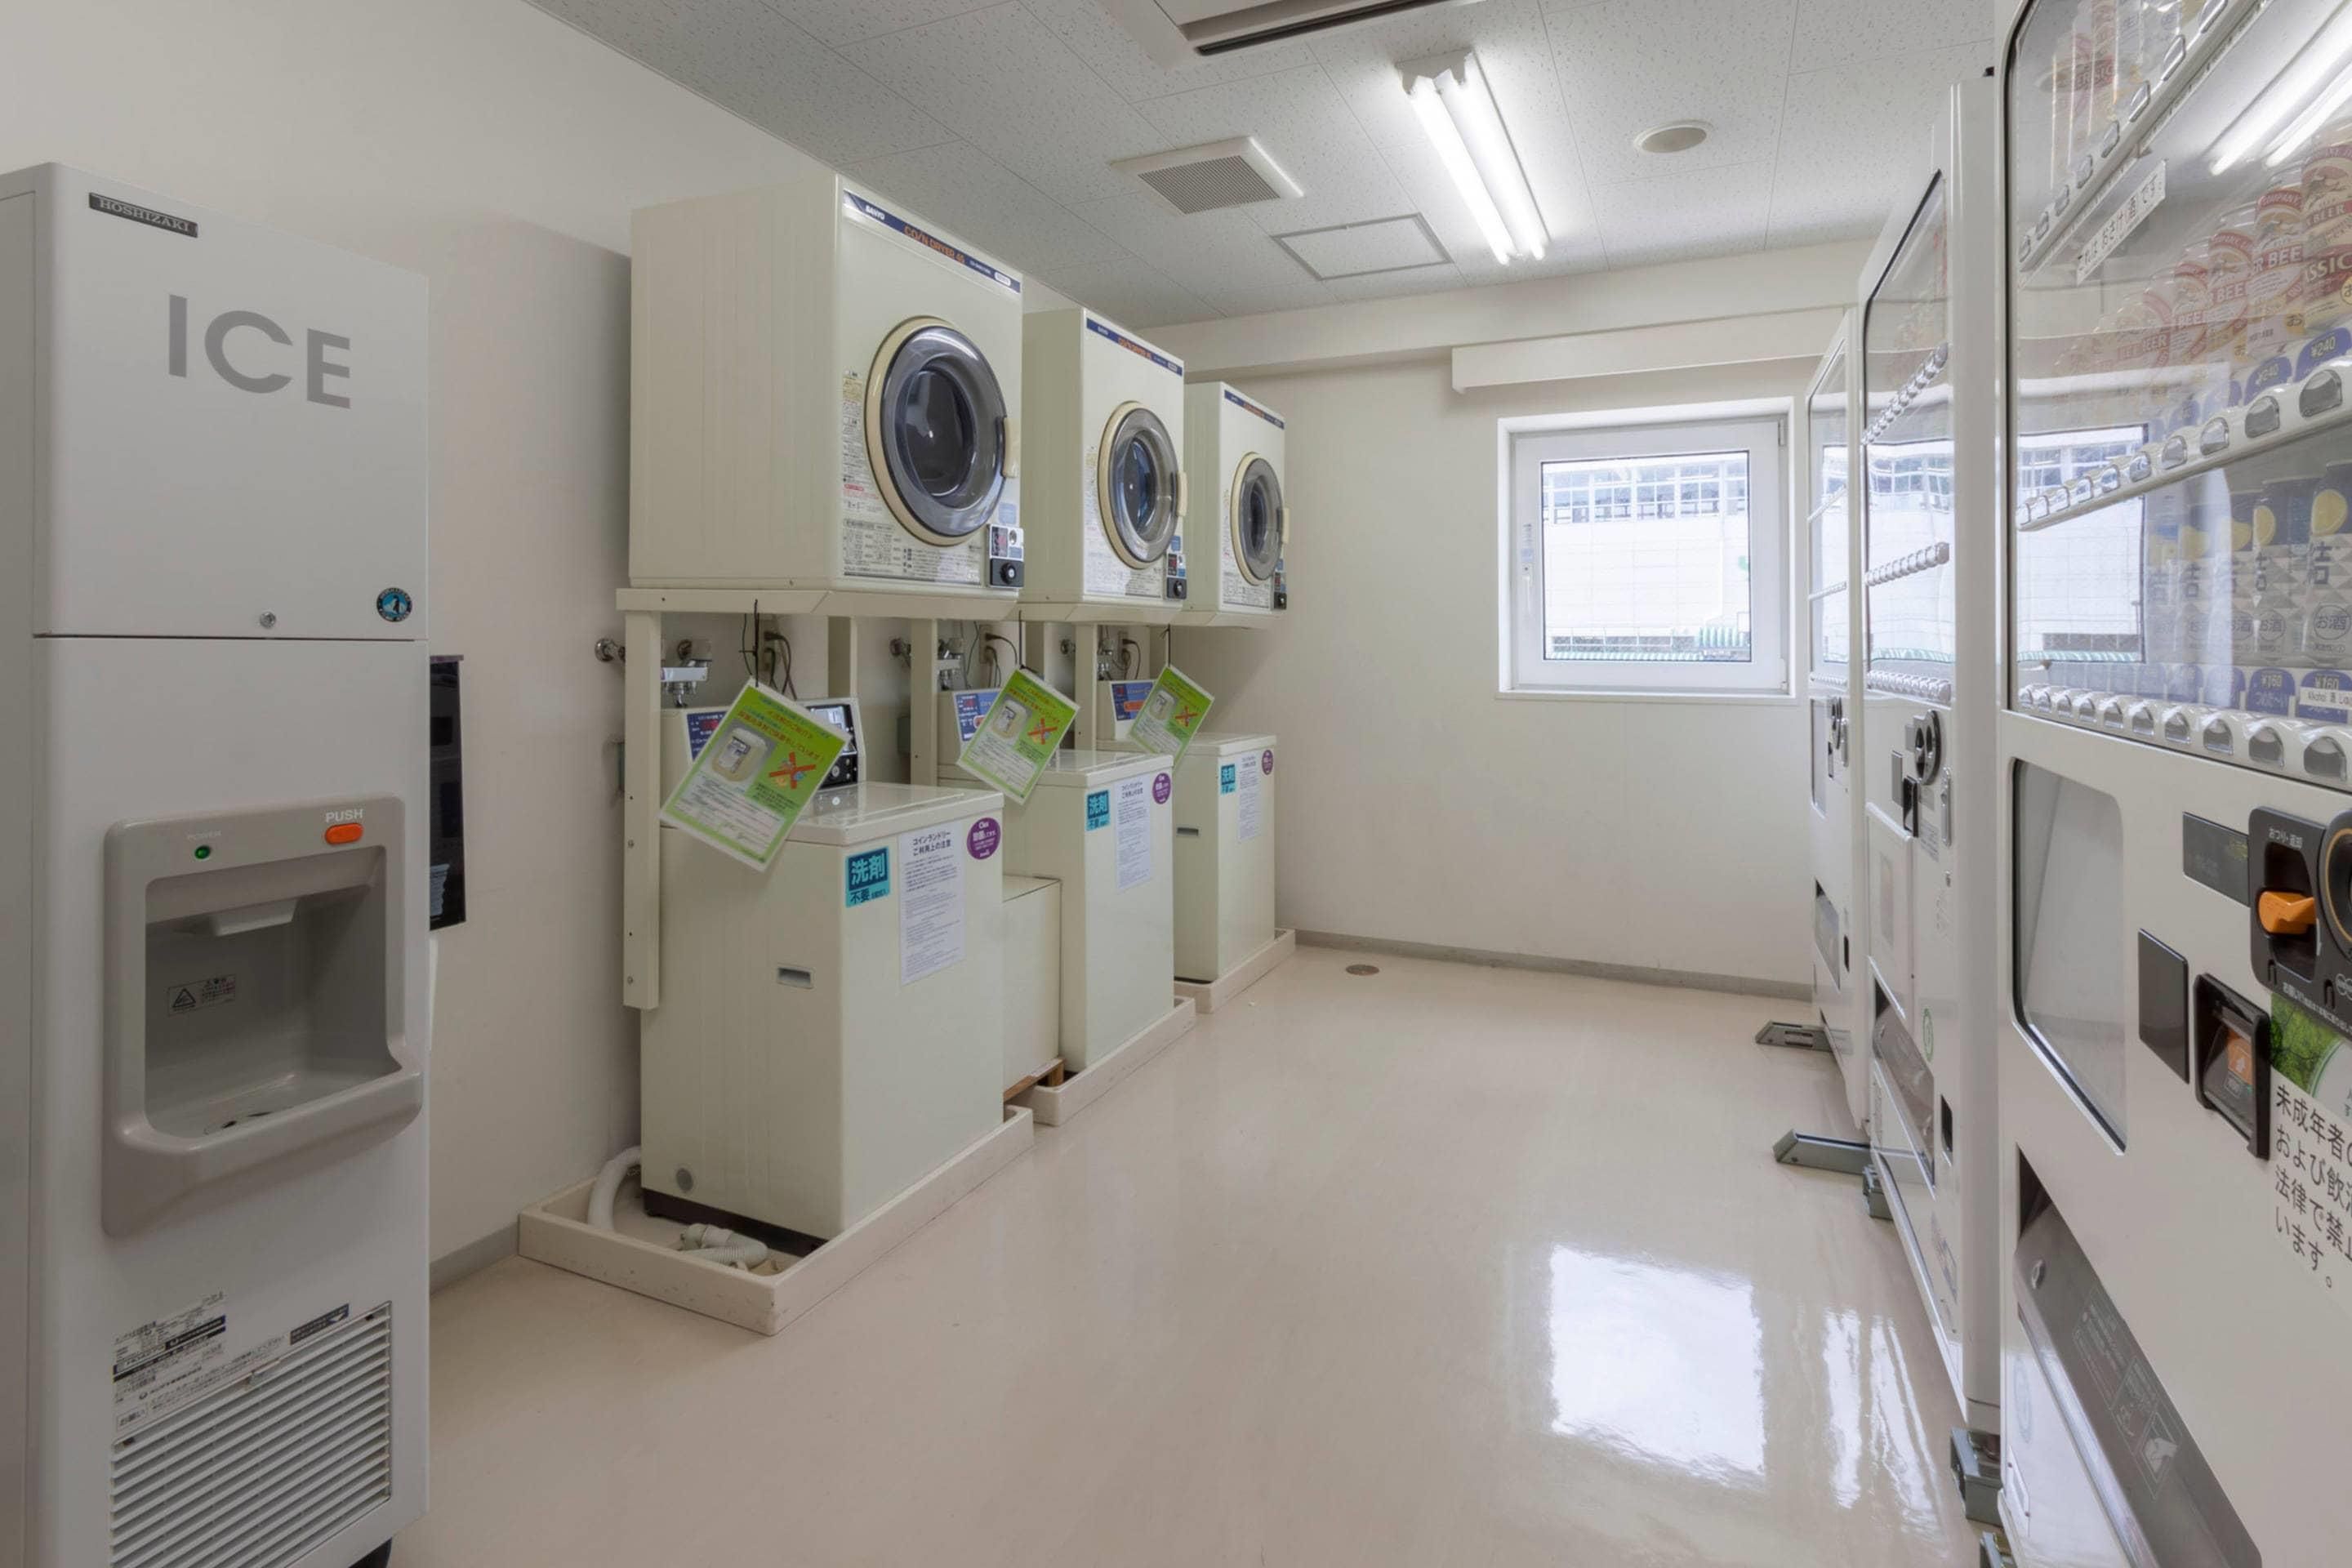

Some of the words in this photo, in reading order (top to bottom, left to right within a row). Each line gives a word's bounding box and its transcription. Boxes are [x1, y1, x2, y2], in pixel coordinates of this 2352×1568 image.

[100, 198, 189, 232] HOSHIZAKI
[2267, 245, 2302, 270] BEE
[2217, 282, 2247, 303] BEE
[168, 294, 352, 409] ICE
[326, 808, 364, 823] PUSH
[913, 831, 951, 846] コインランドリー
[851, 853, 885, 885] 洗剤
[849, 888, 871, 905] 不要
[2275, 1205, 2333, 1290] います。
